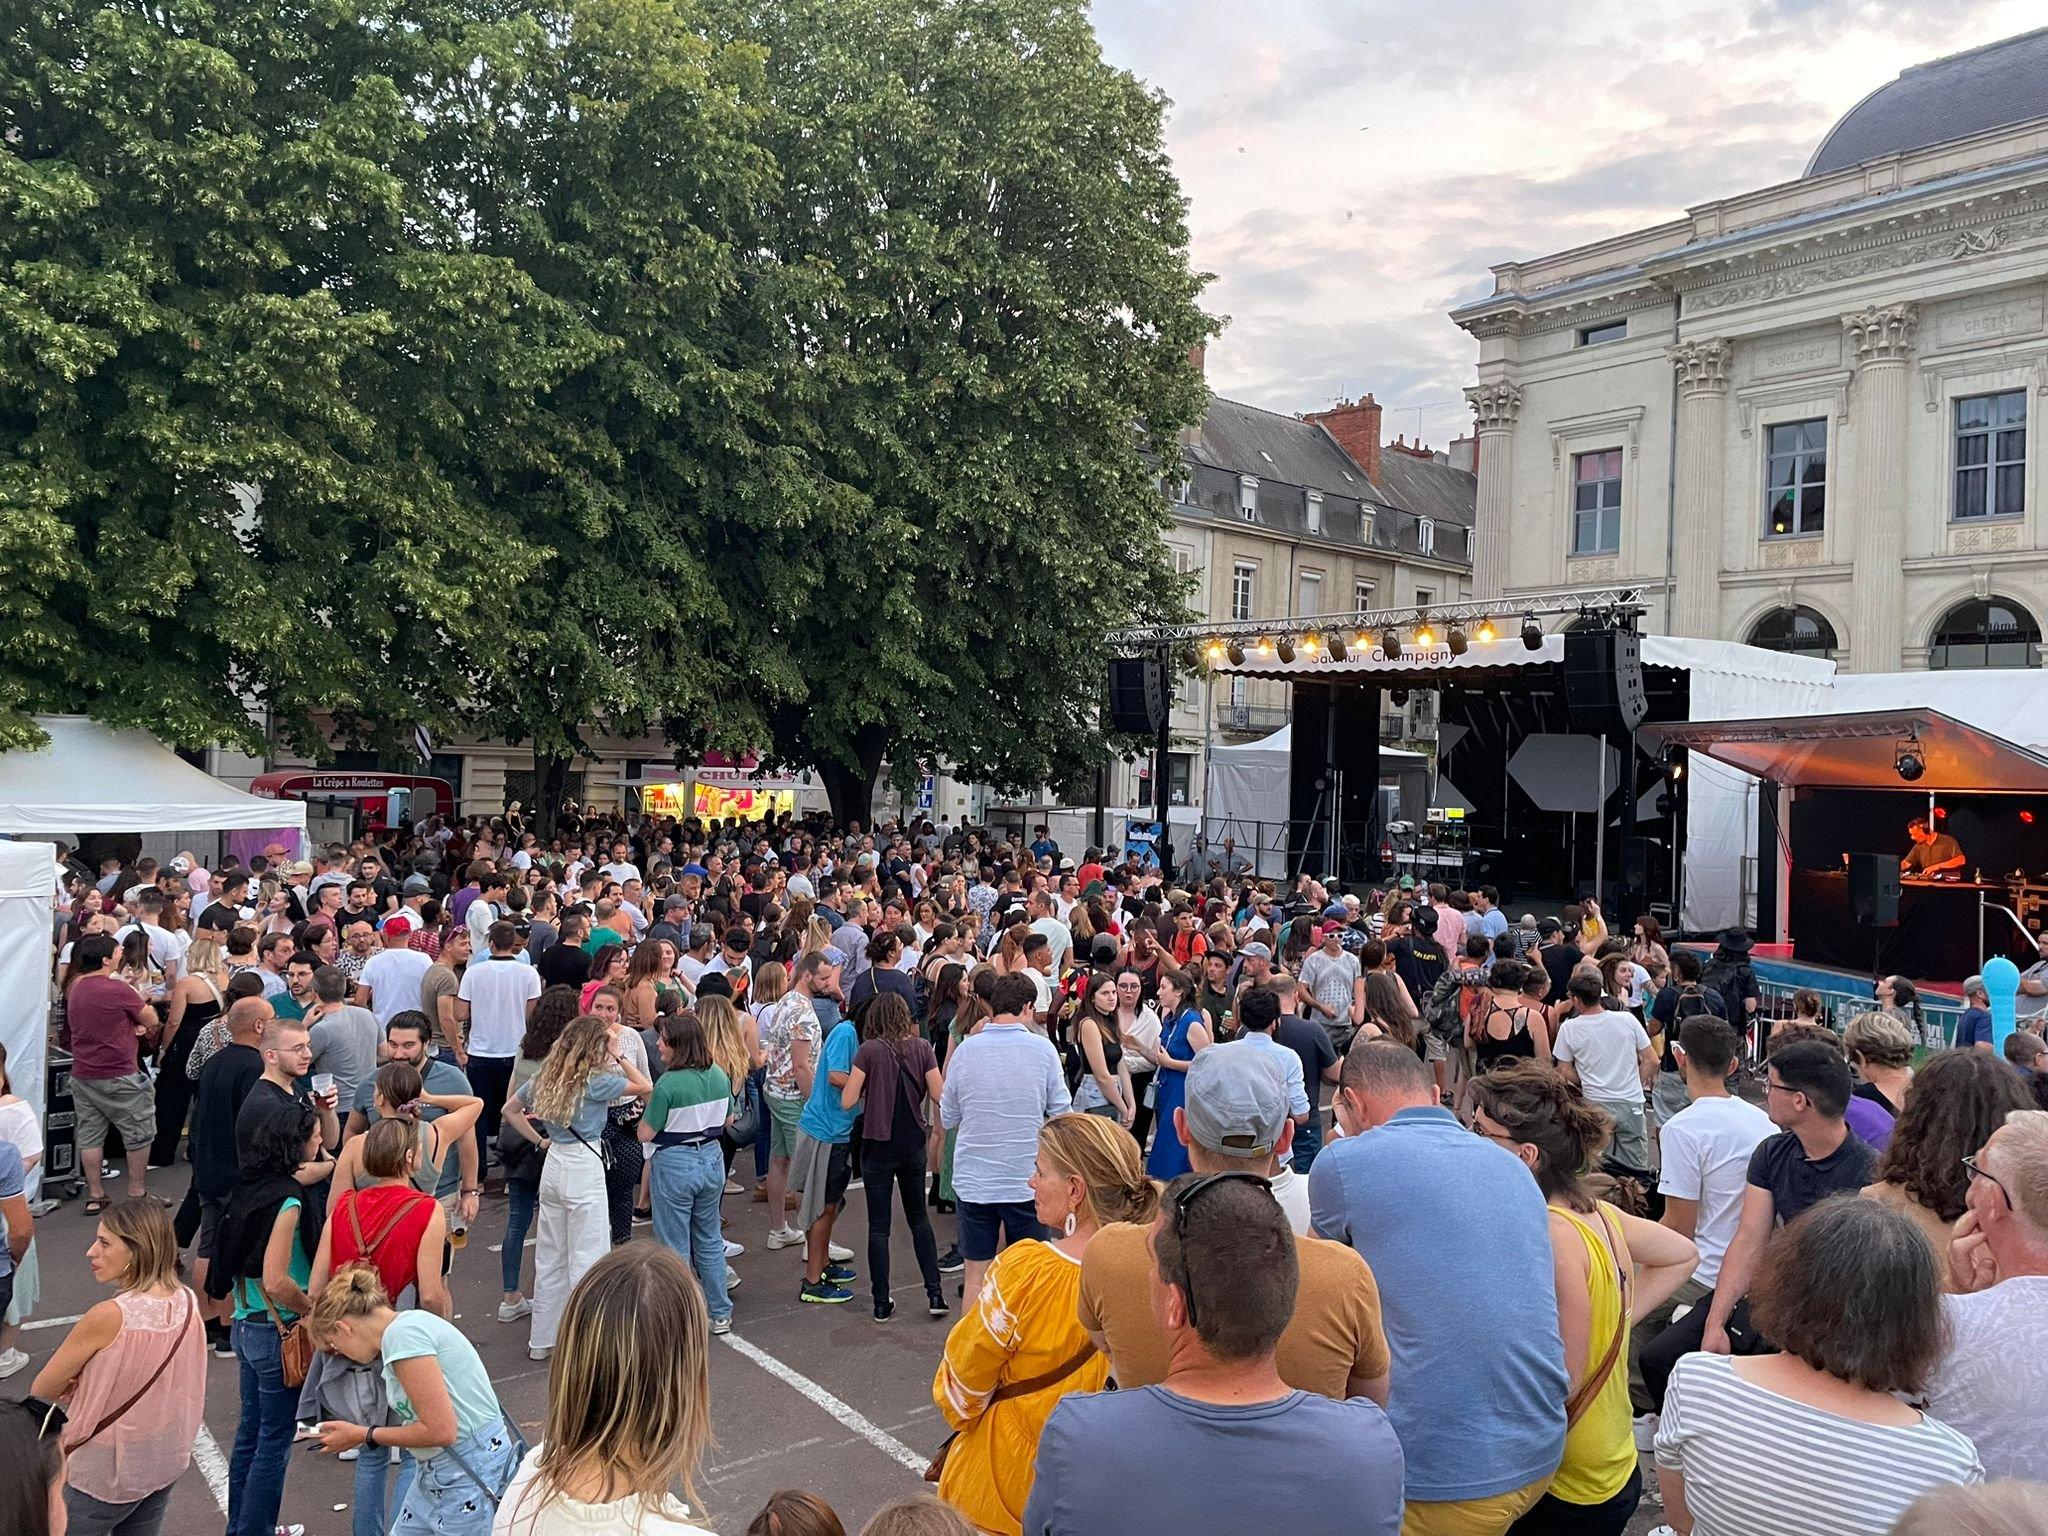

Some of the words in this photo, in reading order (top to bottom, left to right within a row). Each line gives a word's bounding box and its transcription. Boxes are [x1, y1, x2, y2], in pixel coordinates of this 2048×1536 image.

[1311, 652, 1361, 664] Sauur
[1371, 649, 1457, 665] Cmpigny
[697, 771, 793, 780] CHUOS
[313, 777, 322, 787] La
[323, 776, 344, 789] Crêpe
[351, 777, 384, 788] Roulettes
